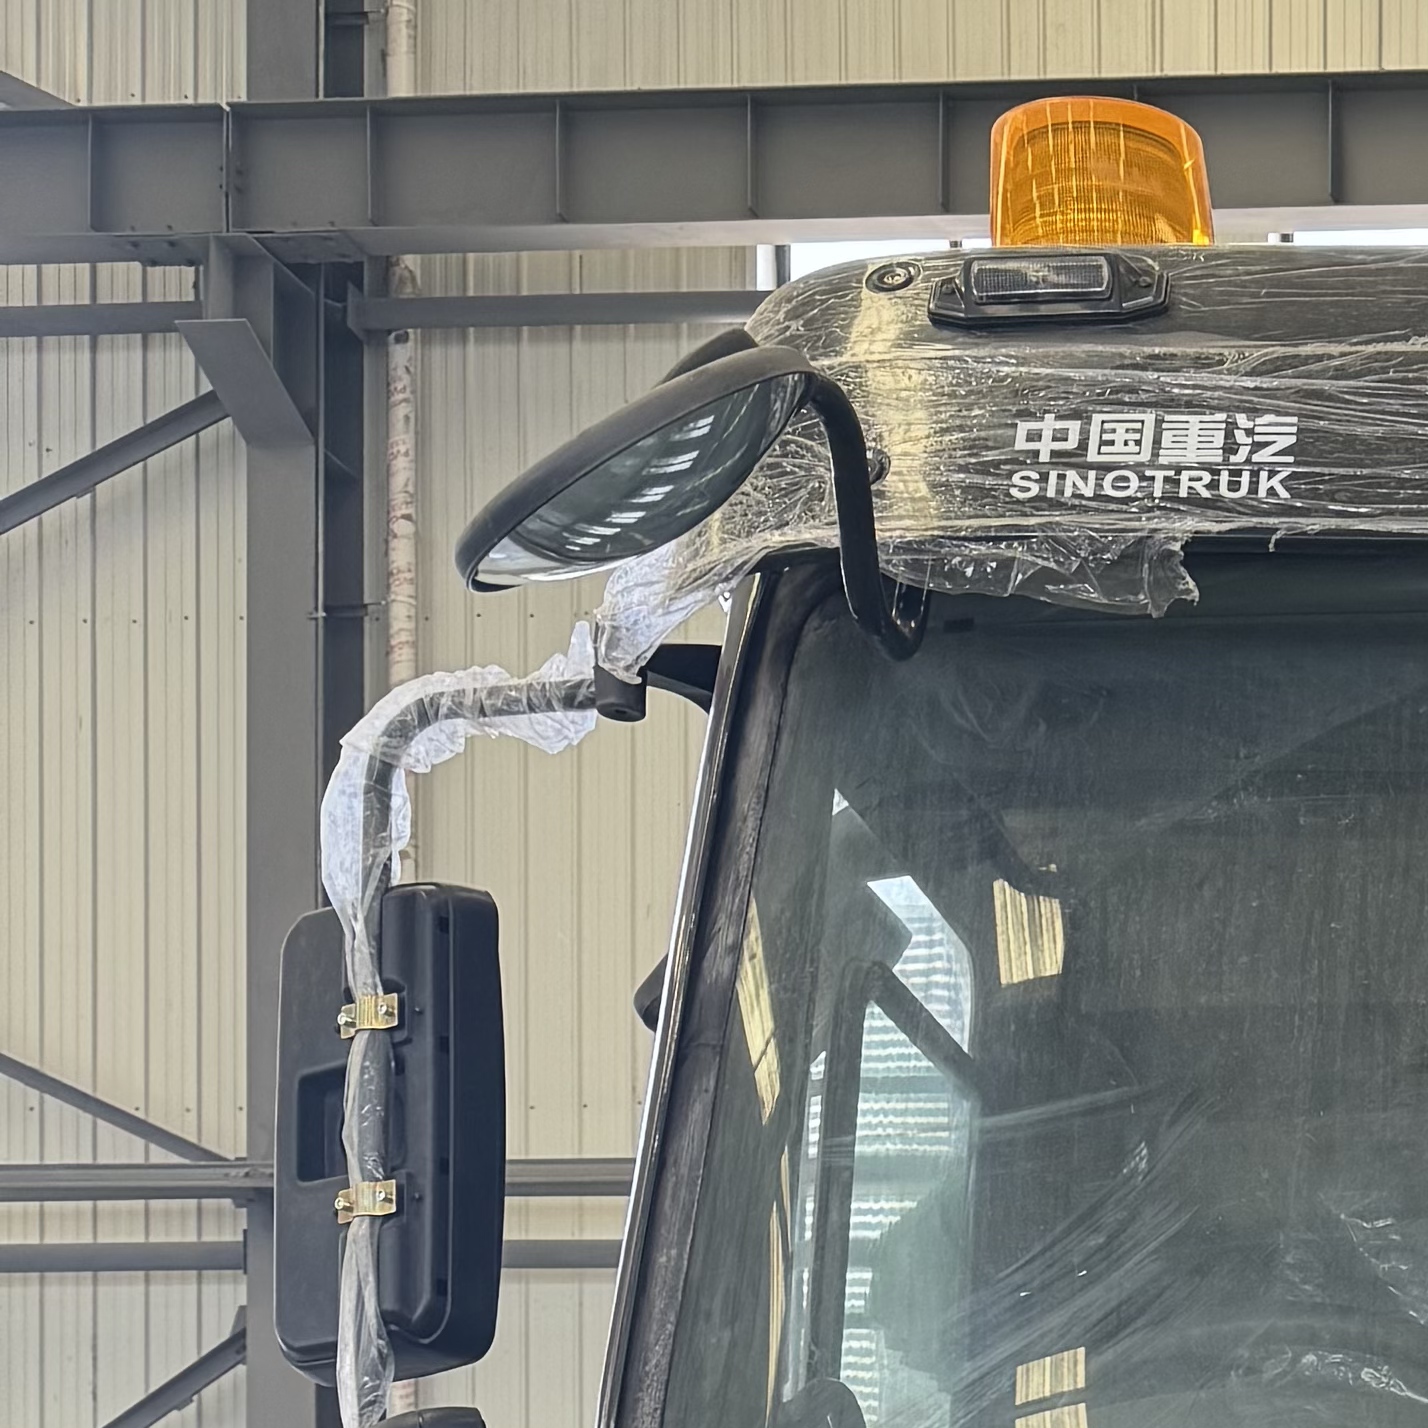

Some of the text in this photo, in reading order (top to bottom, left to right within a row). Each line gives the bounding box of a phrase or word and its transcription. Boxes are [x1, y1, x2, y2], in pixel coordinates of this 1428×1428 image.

[1013, 413, 1299, 463] 中国重汽
[1008, 470, 1293, 499] SINOTRUK
